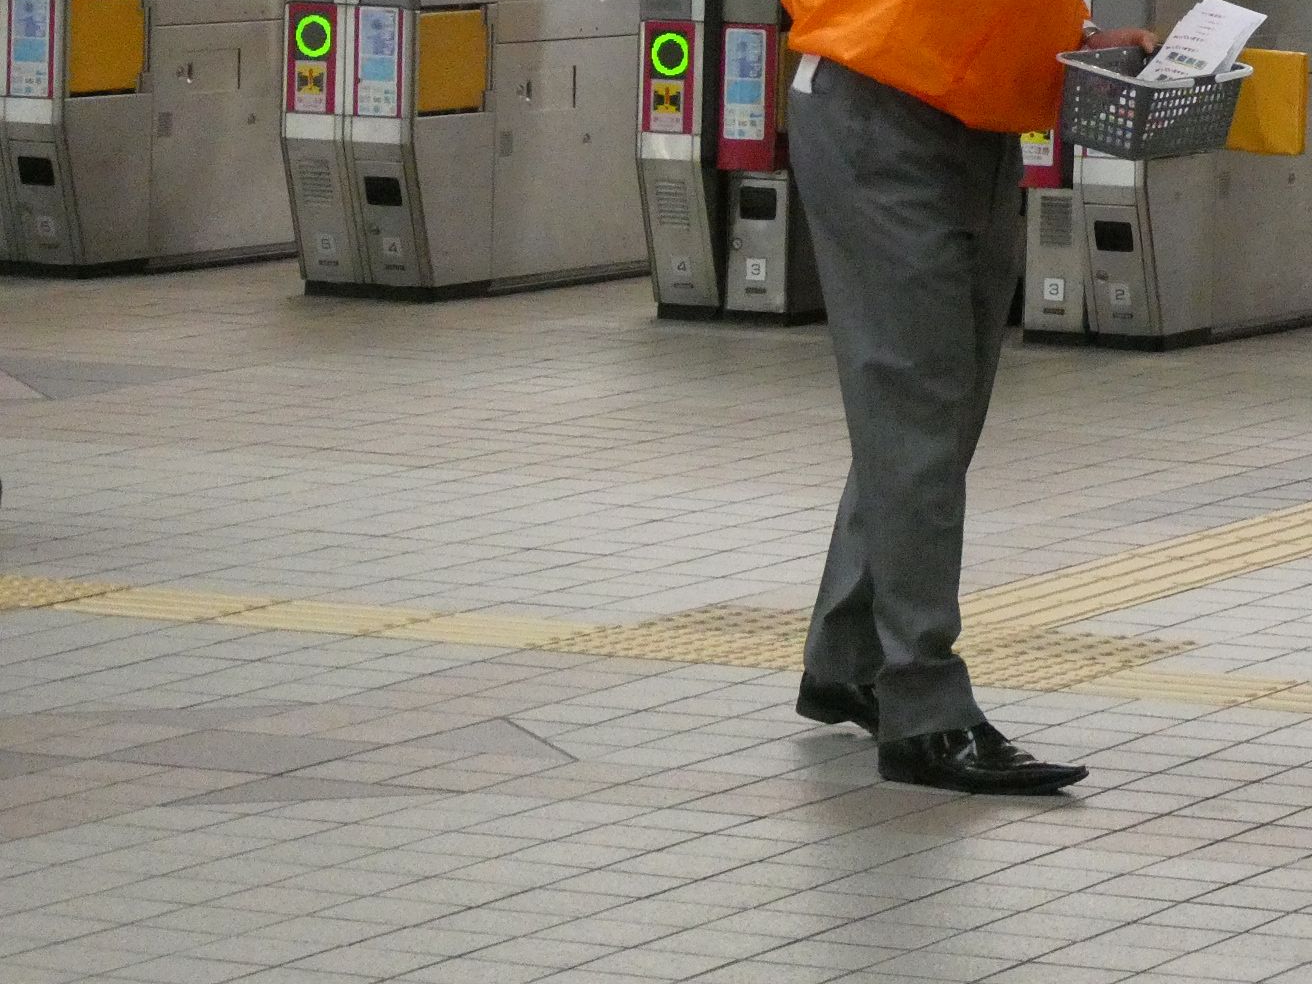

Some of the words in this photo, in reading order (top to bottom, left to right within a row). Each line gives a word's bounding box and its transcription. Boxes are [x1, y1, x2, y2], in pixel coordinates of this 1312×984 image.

[751, 263, 761, 275] 3
[1049, 283, 1059, 295] 3
[1115, 289, 1125, 300] 2
